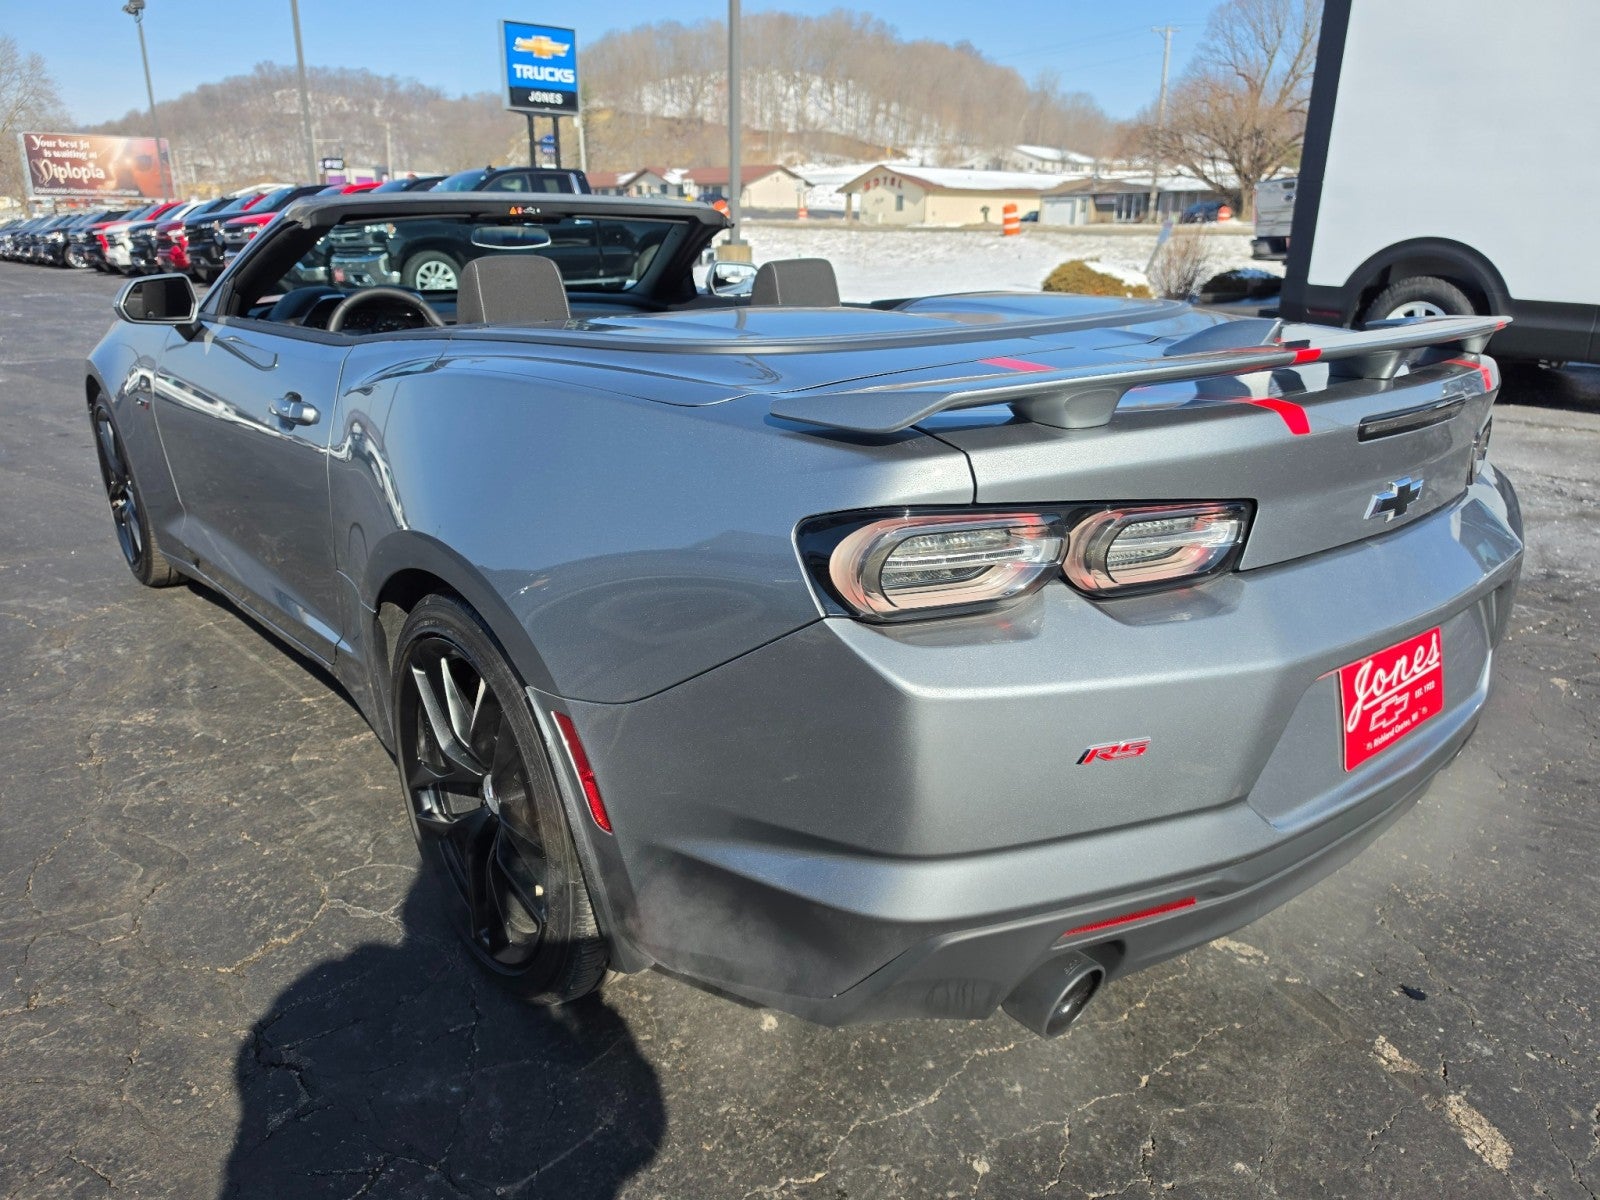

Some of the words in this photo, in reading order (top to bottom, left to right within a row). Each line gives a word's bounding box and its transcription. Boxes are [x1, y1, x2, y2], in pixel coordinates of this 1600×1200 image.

[512, 63, 575, 84] TRUCKS
[528, 90, 564, 105] JONES
[30, 134, 57, 150] Your
[58, 139, 77, 149] best
[43, 149, 52, 157] is
[53, 149, 87, 160] waiting
[30, 158, 105, 187] Diplopia
[1346, 632, 1441, 733] Jones
[1076, 736, 1151, 765] RS
